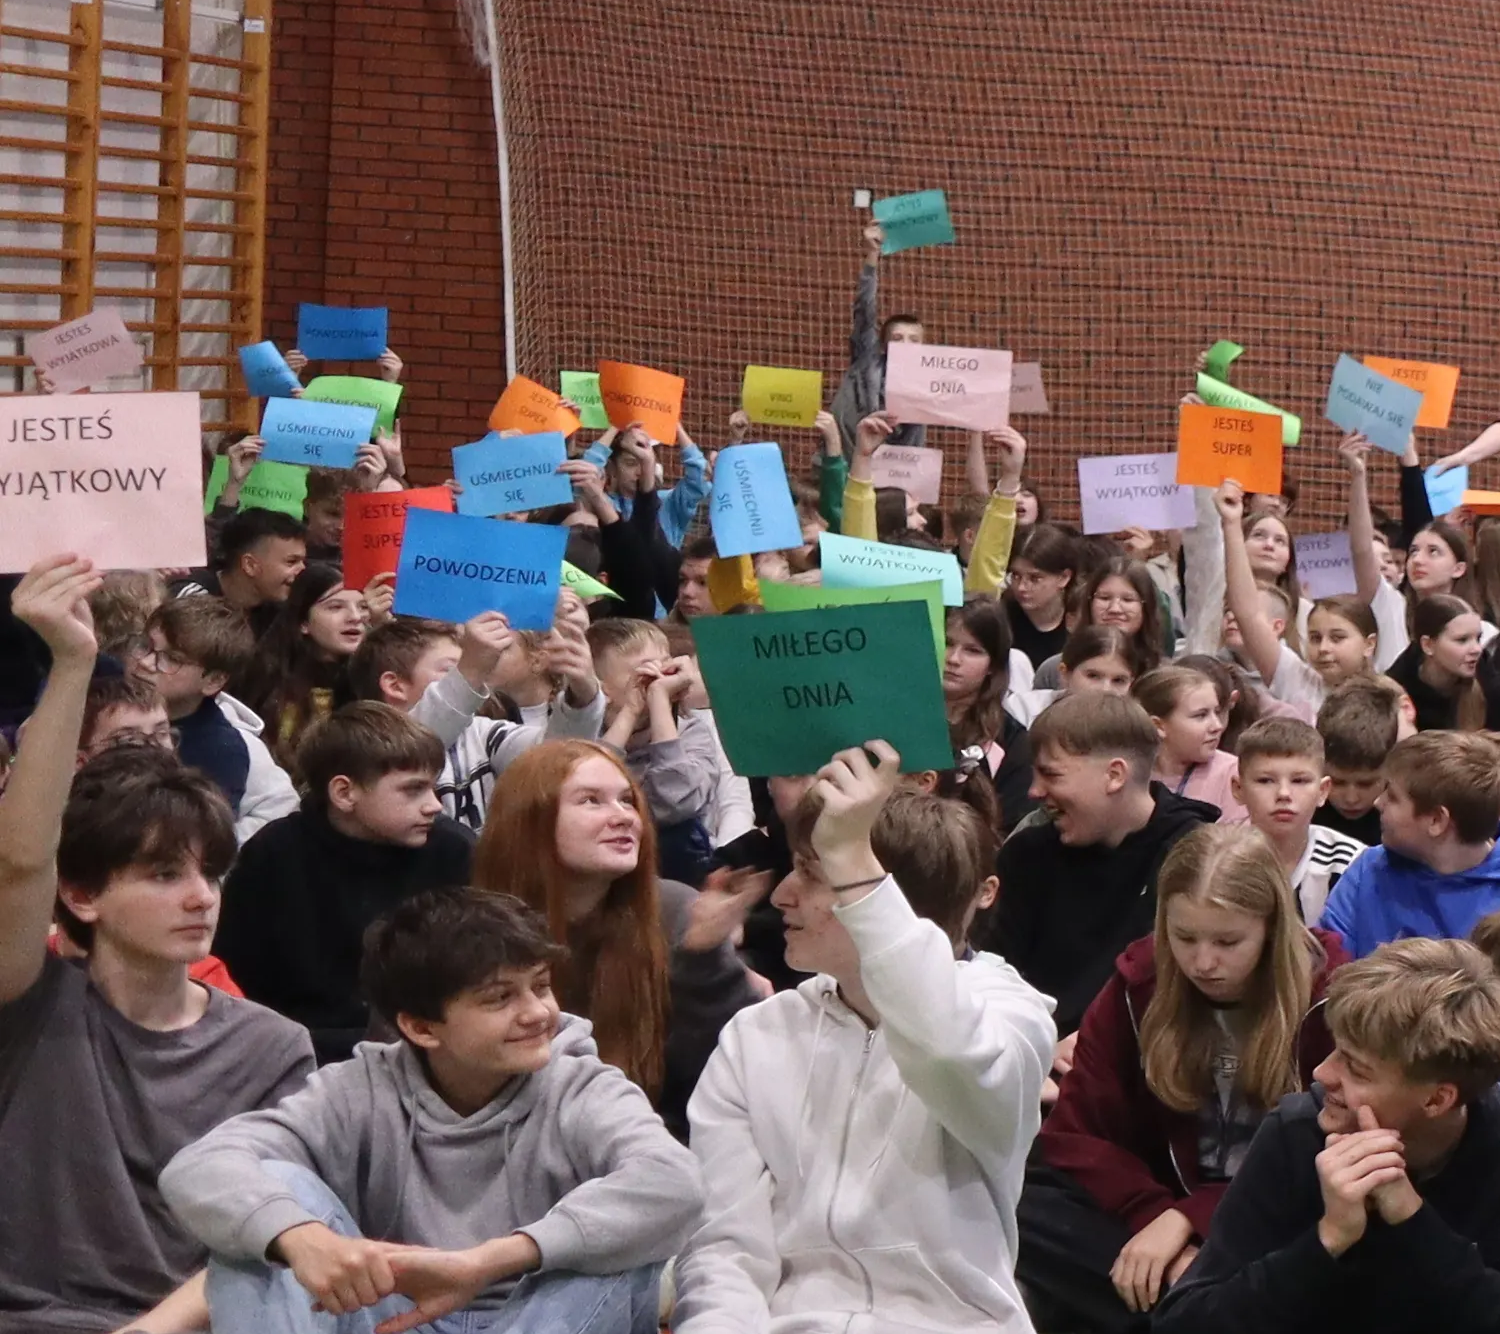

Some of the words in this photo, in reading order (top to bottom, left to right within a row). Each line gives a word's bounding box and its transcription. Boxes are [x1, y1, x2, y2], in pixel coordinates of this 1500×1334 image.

[46, 334, 120, 370] WYJĄTKOWA
[921, 355, 979, 371] MIŁEGO
[930, 380, 966, 396] DNIA
[7, 408, 114, 443] JESTEŚ
[276, 421, 356, 440] UŚMIECHNIJ
[1212, 416, 1255, 433] JESTEŚ
[303, 442, 323, 459] SIĘ
[1212, 443, 1252, 457] SUPER
[469, 462, 552, 488] UŚMIECHNIJ
[1113, 461, 1159, 477] JESTEŚ
[0, 467, 167, 501] YJĄTKOWY
[1095, 483, 1181, 501] WYJĄTKOWY
[504, 488, 526, 504] SIĘ
[717, 492, 734, 513] SIĘ
[733, 458, 766, 538] UŚMIECHNIJ
[363, 532, 402, 549] SUPE
[1296, 536, 1331, 551] ESTEŚ
[414, 555, 548, 587] POWODZENIA
[838, 553, 944, 576] WYJĄTKOWY
[1296, 556, 1351, 571] ĄTKOWY
[753, 627, 867, 660] MIŁEGO
[782, 681, 854, 710] DNIA
